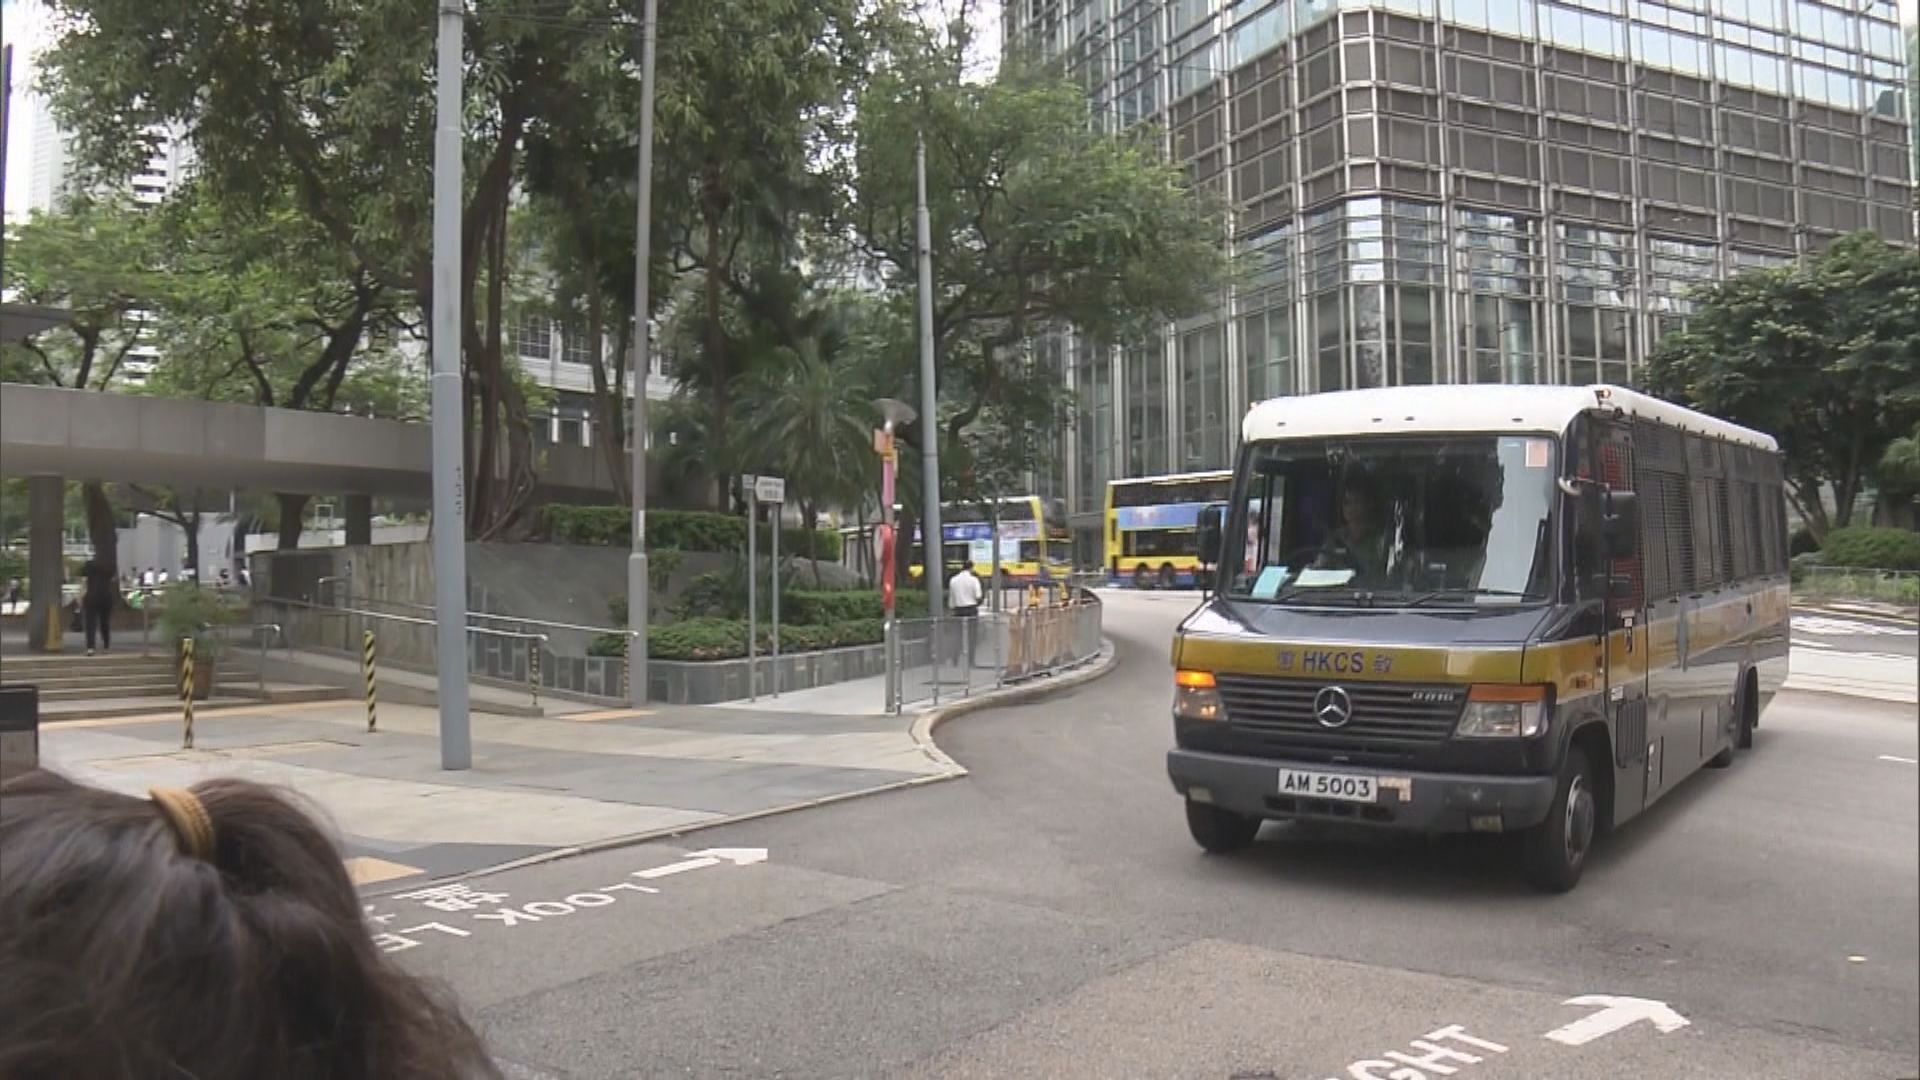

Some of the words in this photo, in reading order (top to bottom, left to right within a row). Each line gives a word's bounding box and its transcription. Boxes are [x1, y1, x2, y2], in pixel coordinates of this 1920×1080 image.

[1303, 652, 1364, 673] HKCS
[1285, 773, 1310, 791] AM
[1316, 776, 1370, 797] 5003
[473, 882, 660, 926] LOOK
[371, 921, 472, 953] LE
[1325, 1024, 1509, 1080] GHT
